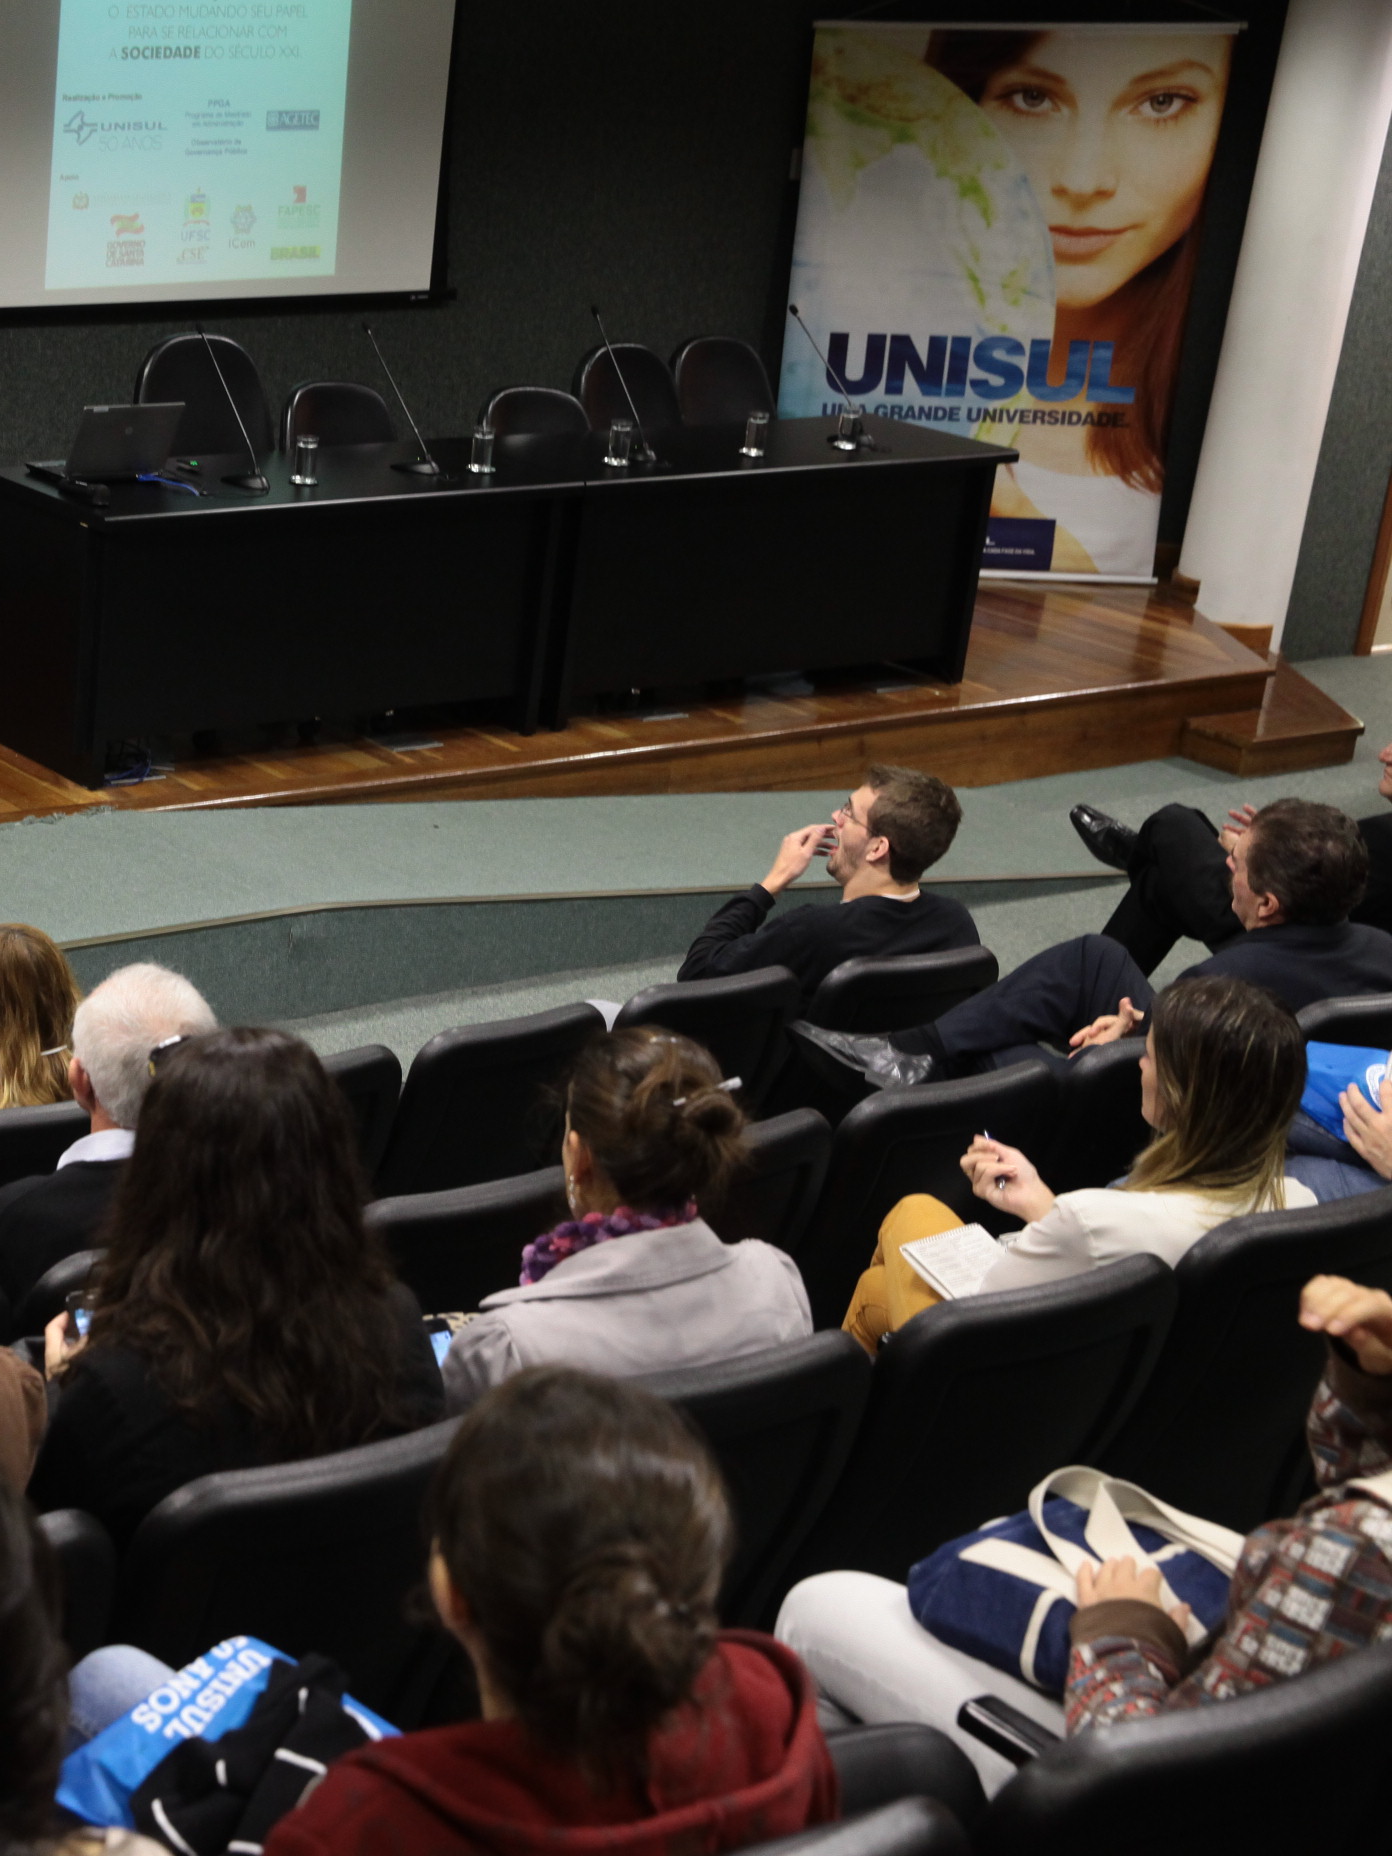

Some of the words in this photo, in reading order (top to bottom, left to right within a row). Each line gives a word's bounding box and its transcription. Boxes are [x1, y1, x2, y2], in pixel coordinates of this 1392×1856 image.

[127, 5, 175, 20] ESTADO
[179, 4, 247, 19] MUDANDO
[250, 4, 273, 18] SEU
[276, 4, 308, 18] PAPEL
[128, 26, 158, 39] PARA
[161, 25, 175, 39] SE
[178, 25, 254, 39] RELACIONAR
[258, 24, 287, 38] COM
[110, 48, 118, 60] A
[121, 46, 201, 60] SOCIEDADE
[205, 46, 223, 60] DO
[228, 43, 276, 60] SÉCULO
[100, 121, 167, 132] UNISUL
[181, 230, 211, 242] UFSC
[825, 332, 1136, 404] UNISUL
[874, 403, 961, 423] GRANDE
[131, 1656, 214, 1733] ANOS
[163, 1648, 273, 1738] UNISUL
